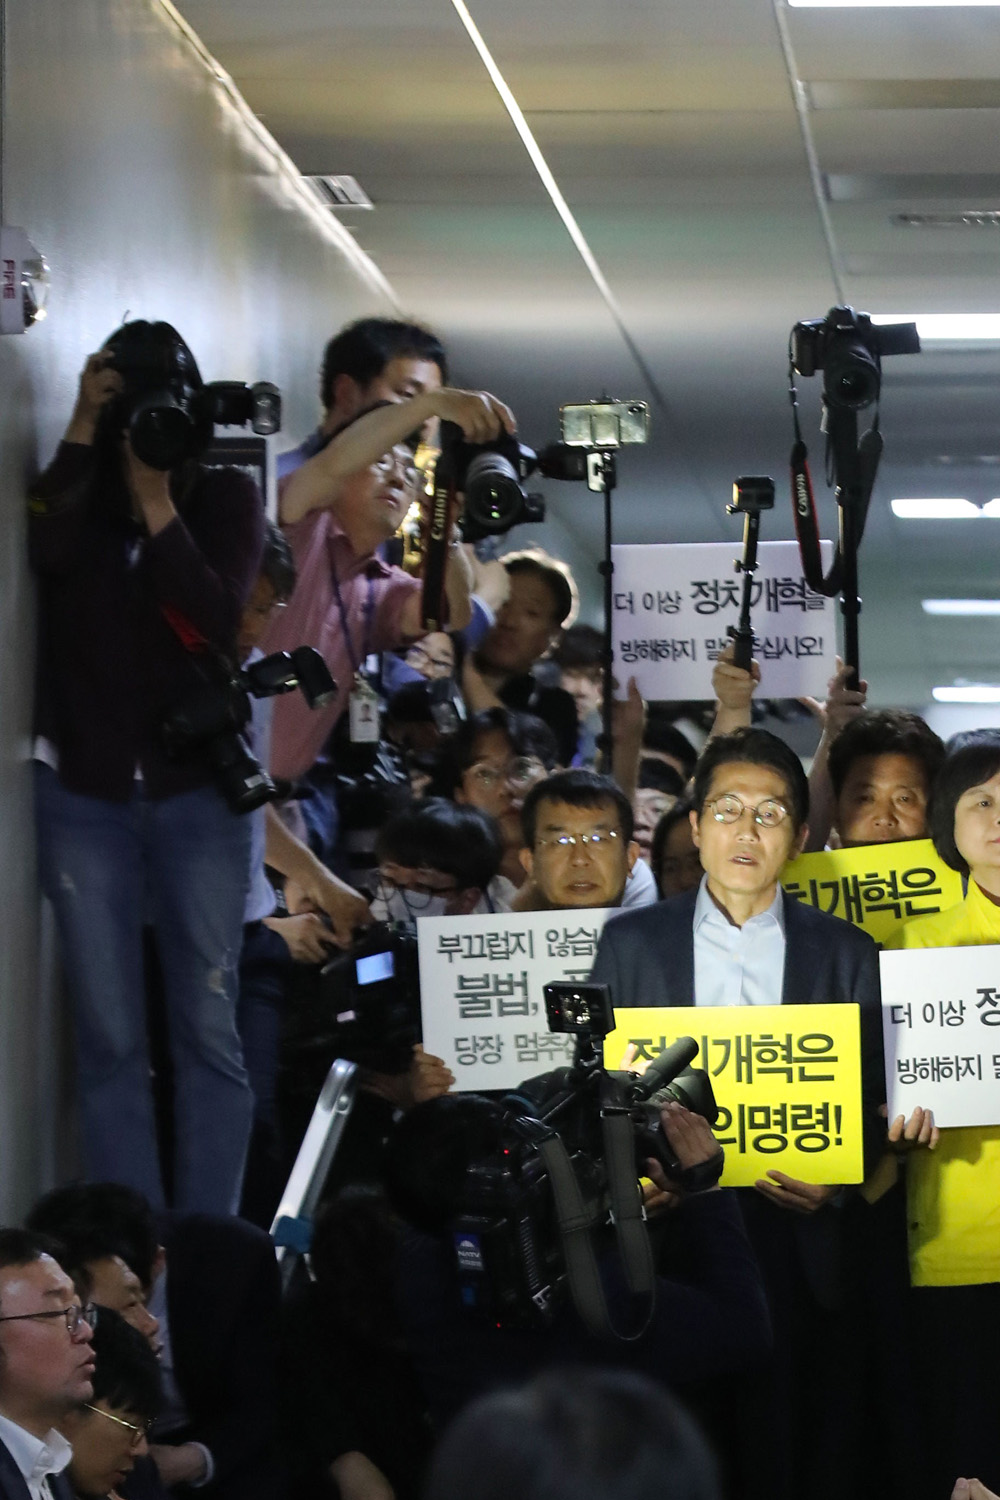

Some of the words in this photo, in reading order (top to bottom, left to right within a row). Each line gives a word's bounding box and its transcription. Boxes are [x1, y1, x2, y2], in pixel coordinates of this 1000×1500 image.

[2, 259, 16, 299] FIRE
[796, 473, 809, 517] Canon
[431, 488, 448, 540] Canon
[613, 591, 634, 614] 더
[642, 589, 682, 614] 이상
[620, 637, 697, 663] 방해하지
[437, 929, 535, 963] 부끄럽지
[545, 926, 600, 958] 않습
[454, 970, 539, 1020] 불법,
[890, 1002, 913, 1029] 더
[922, 999, 967, 1027] 이상
[454, 1033, 504, 1066] 당장
[896, 1053, 983, 1085] 방해하지
